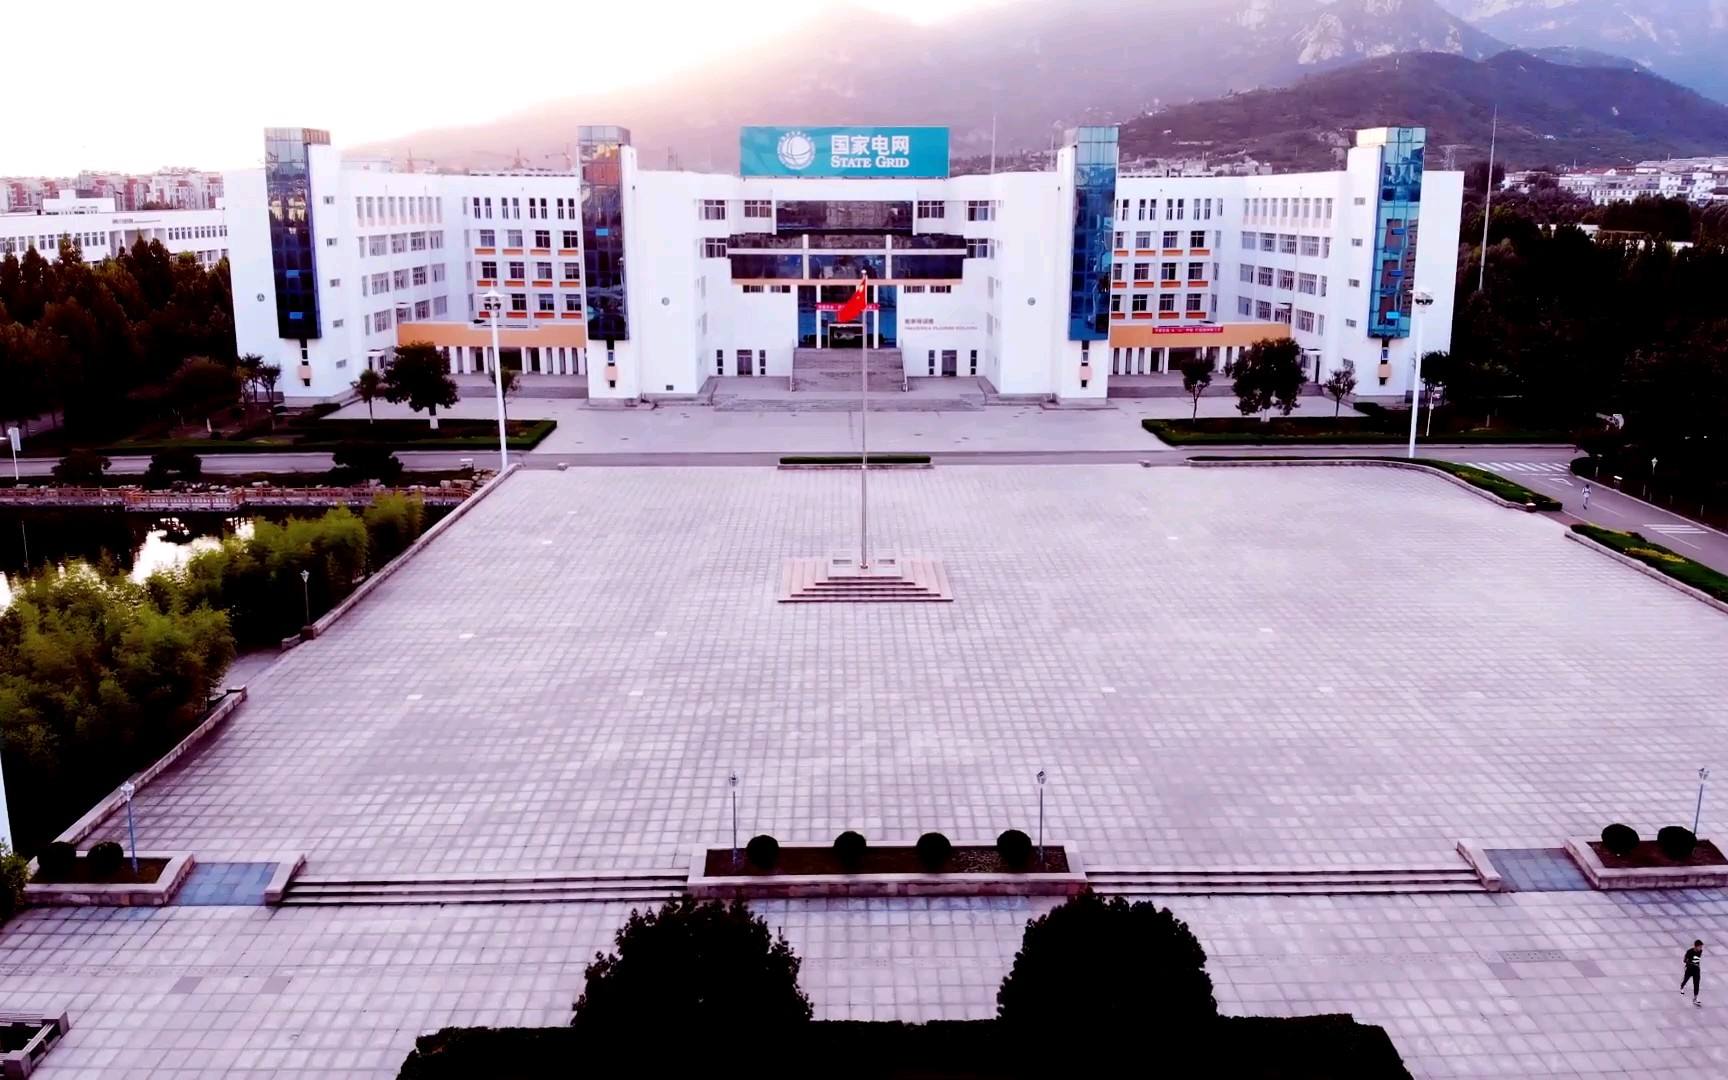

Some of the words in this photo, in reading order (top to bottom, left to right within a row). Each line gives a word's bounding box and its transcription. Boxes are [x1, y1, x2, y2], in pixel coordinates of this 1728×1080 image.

[831, 134, 909, 155] 国家电网
[831, 155, 872, 168] STATE
[875, 155, 910, 168] GRID
